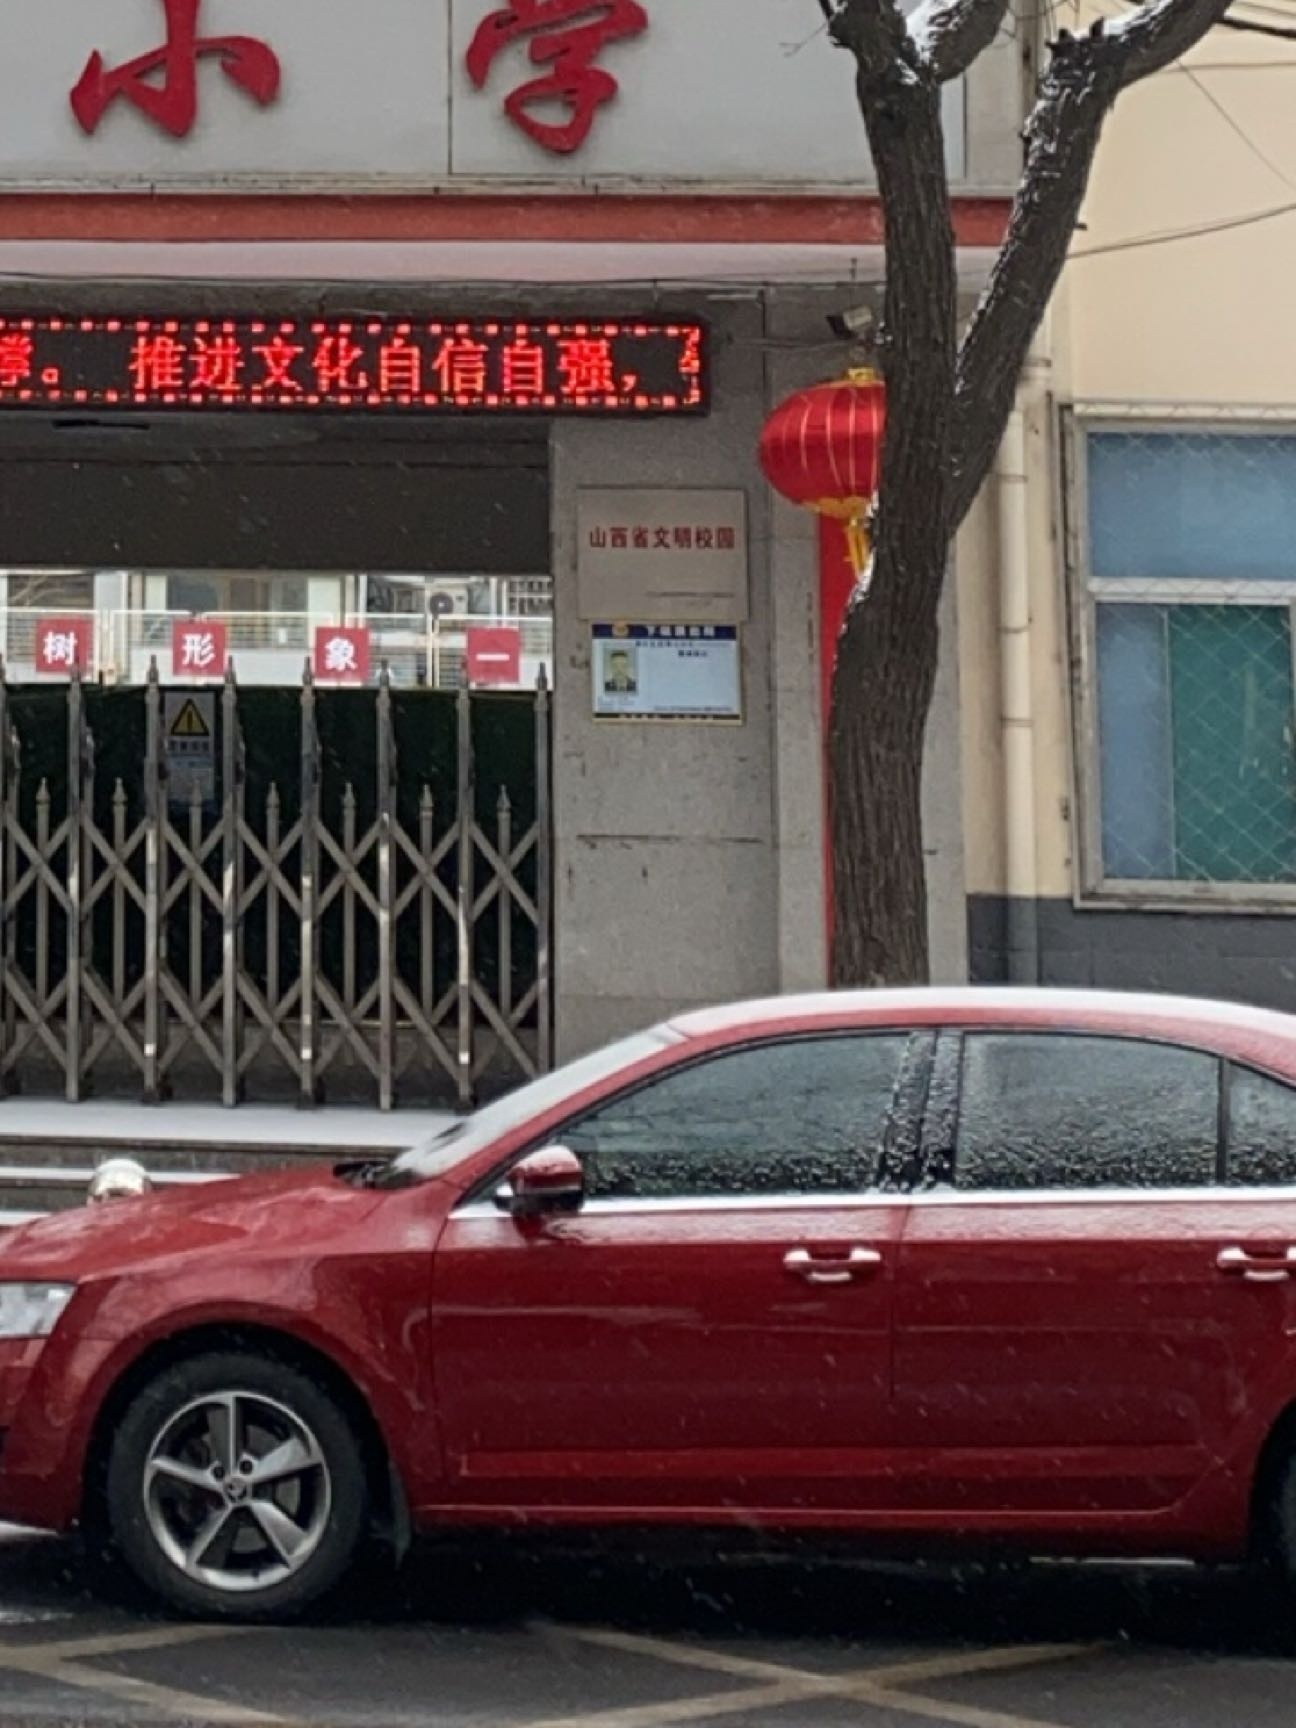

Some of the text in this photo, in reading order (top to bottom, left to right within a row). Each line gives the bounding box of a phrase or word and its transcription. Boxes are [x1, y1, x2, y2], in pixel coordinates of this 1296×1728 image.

[589, 526, 736, 550] 山西省文明校园
